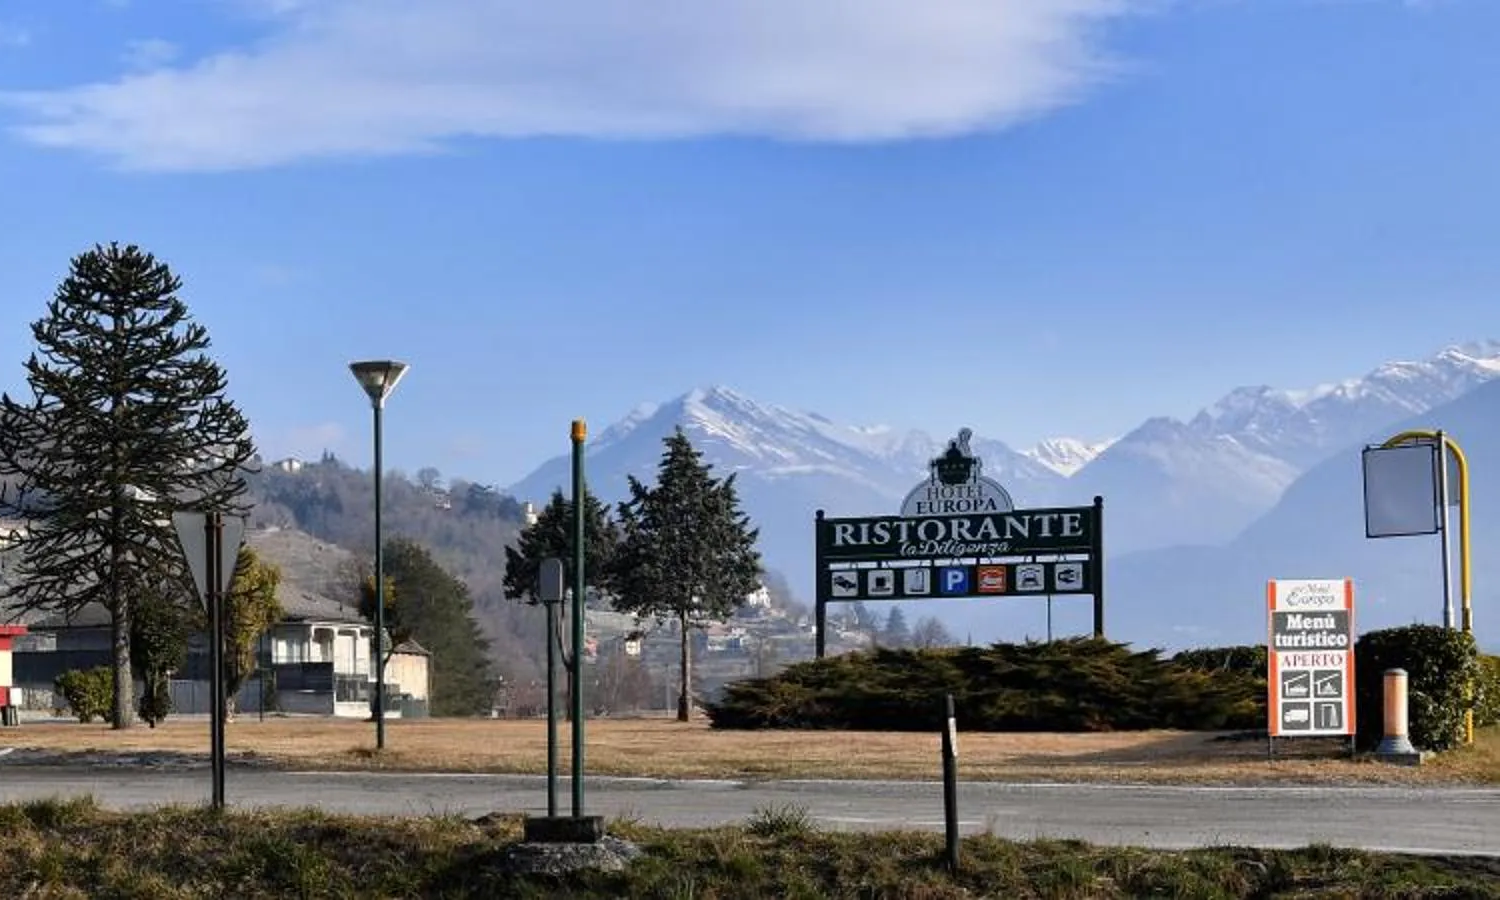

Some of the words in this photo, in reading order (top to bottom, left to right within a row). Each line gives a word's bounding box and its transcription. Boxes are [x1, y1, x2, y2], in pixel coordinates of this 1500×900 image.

[927, 485, 987, 500] HOTEL
[916, 498, 997, 514] EUROPA
[833, 513, 1084, 546] RISTORANTE
[1275, 631, 1348, 647] turistico
[1282, 653, 1343, 667] APERTO
